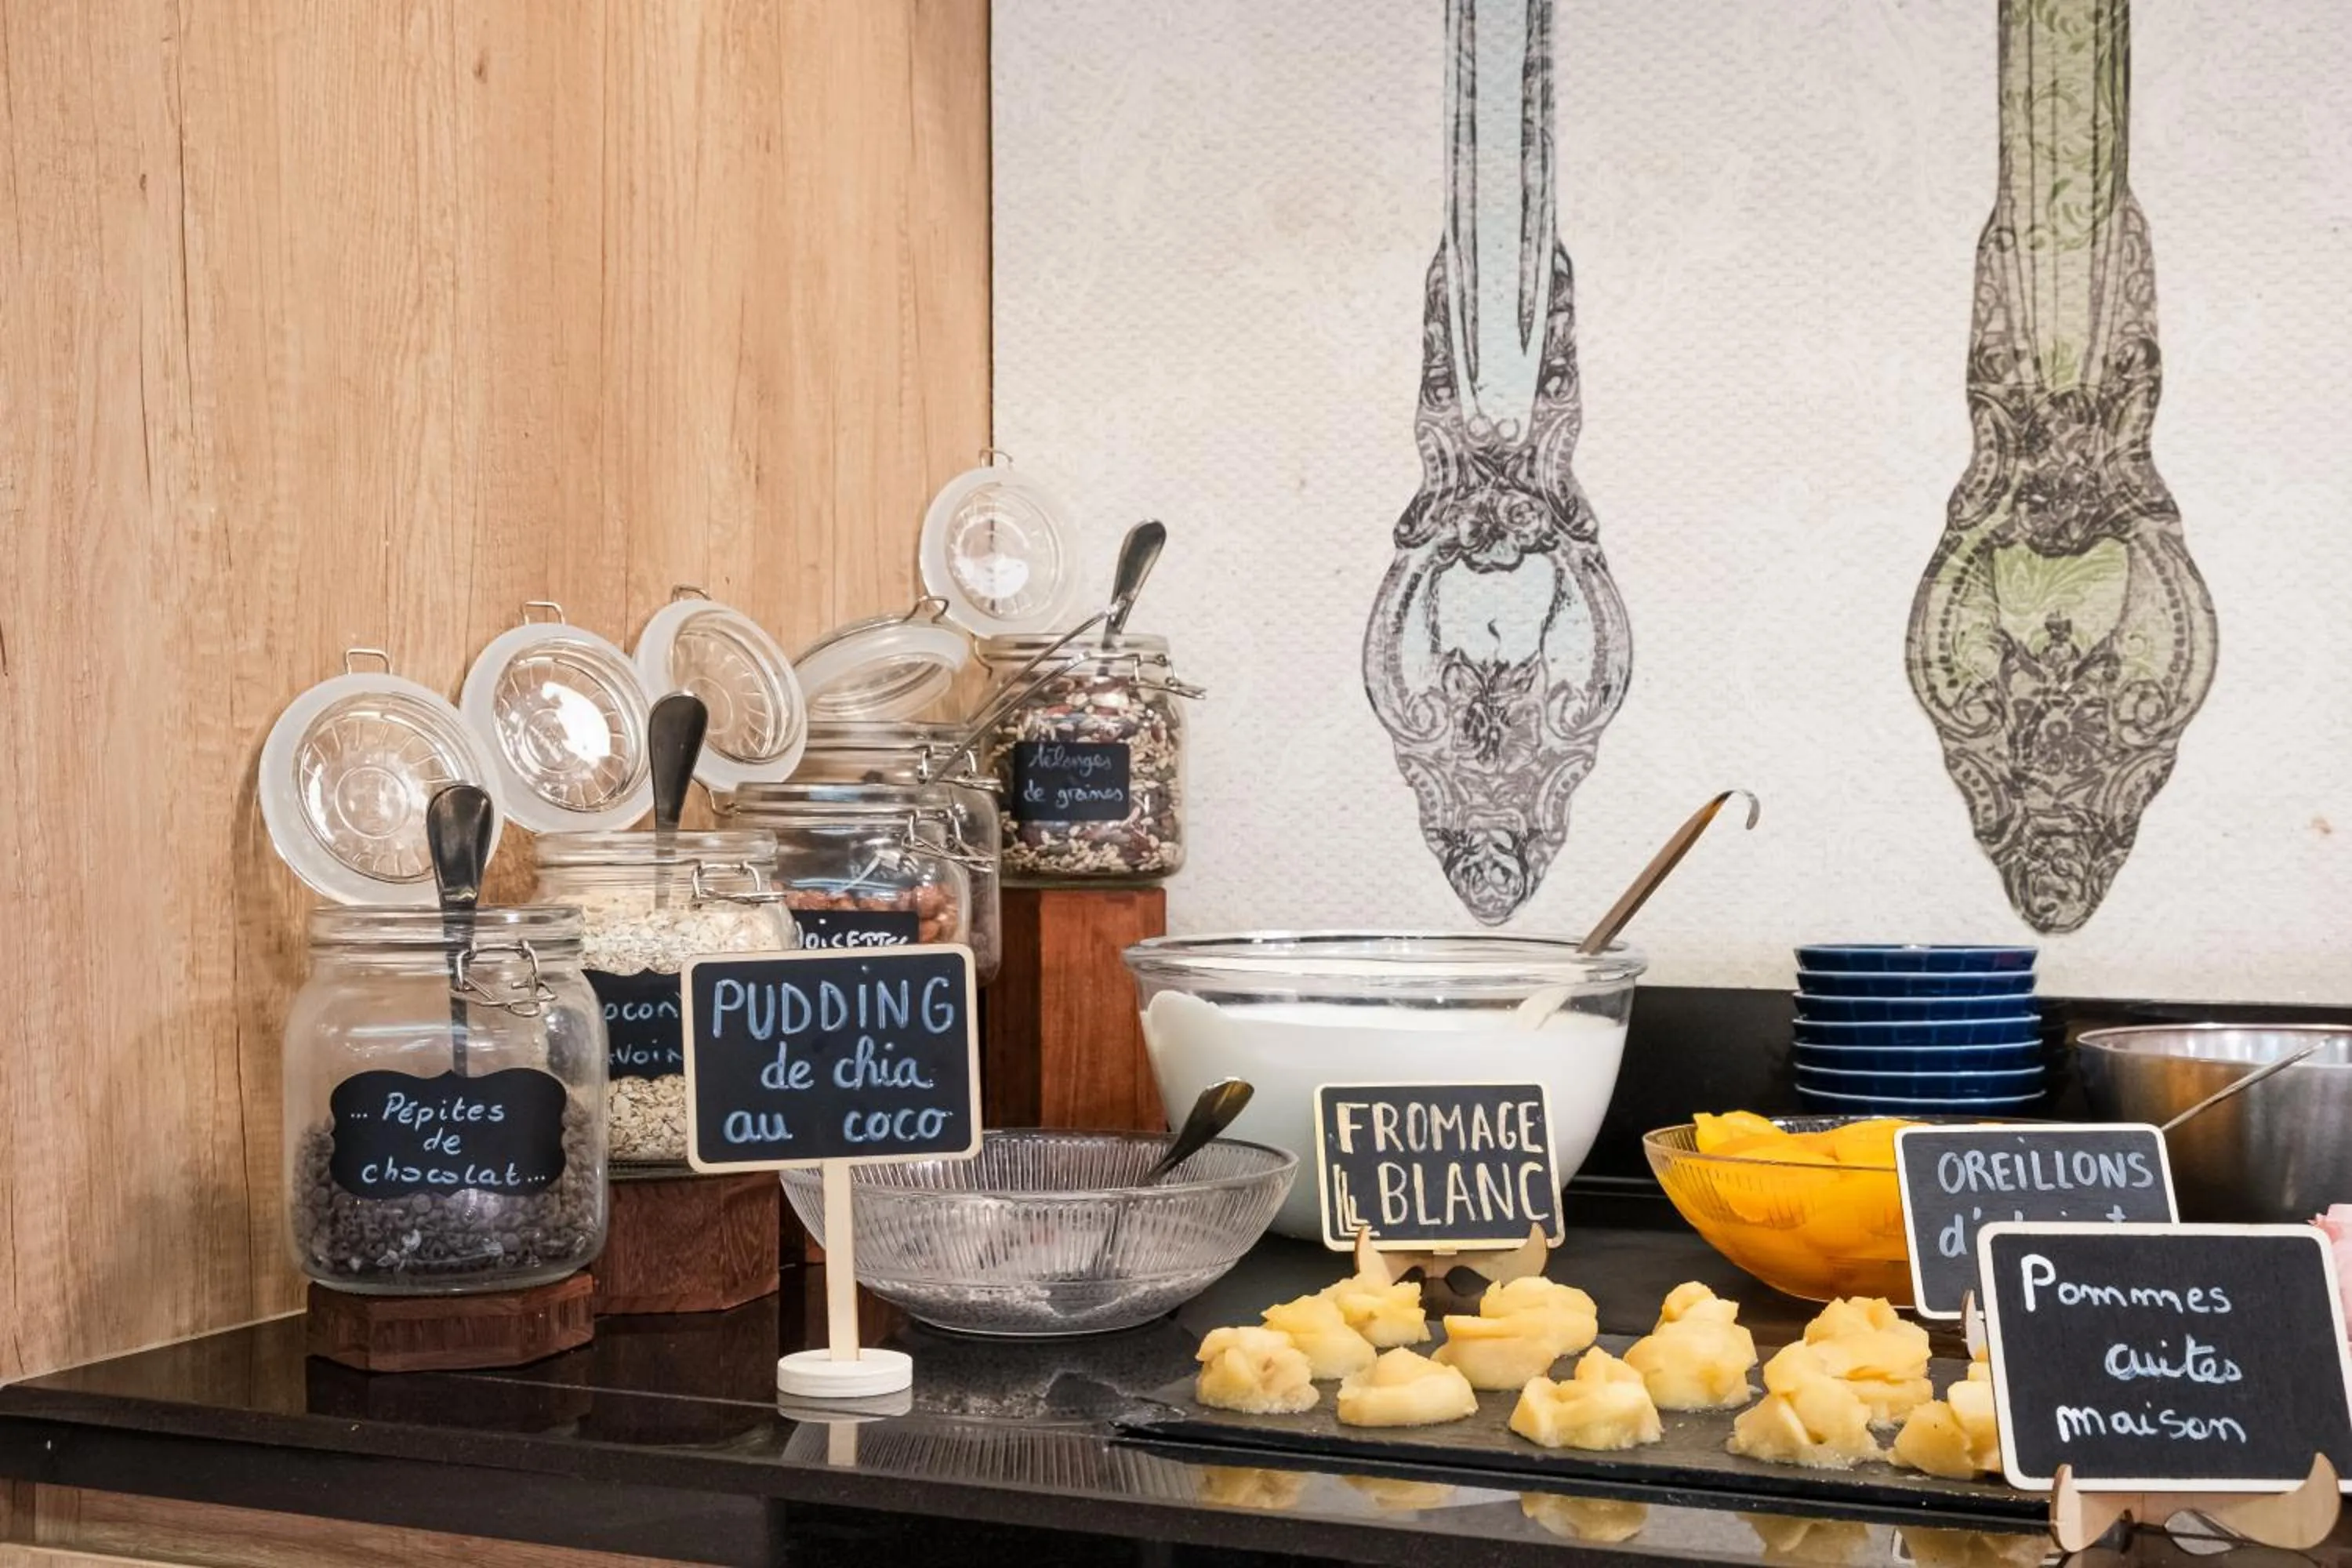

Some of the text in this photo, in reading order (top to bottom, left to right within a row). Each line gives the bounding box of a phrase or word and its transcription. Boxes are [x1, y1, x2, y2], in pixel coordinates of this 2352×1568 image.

[1022, 778, 1124, 810] de graines
[604, 991, 682, 1021] ocon
[713, 964, 954, 1040] PUDDING
[760, 1035, 935, 1091] de chia
[382, 1091, 505, 1131] Pépites
[724, 1107, 953, 1144] au coco
[1335, 1101, 1544, 1154] FROMAGE
[423, 1127, 462, 1156] de
[1937, 1135, 2154, 1194] OREILLONS
[1377, 1162, 1550, 1226] BLANC
[2020, 1253, 2232, 1314] Pommes
[2104, 1334, 2243, 1385] cuites
[2056, 1401, 2247, 1443] maison
